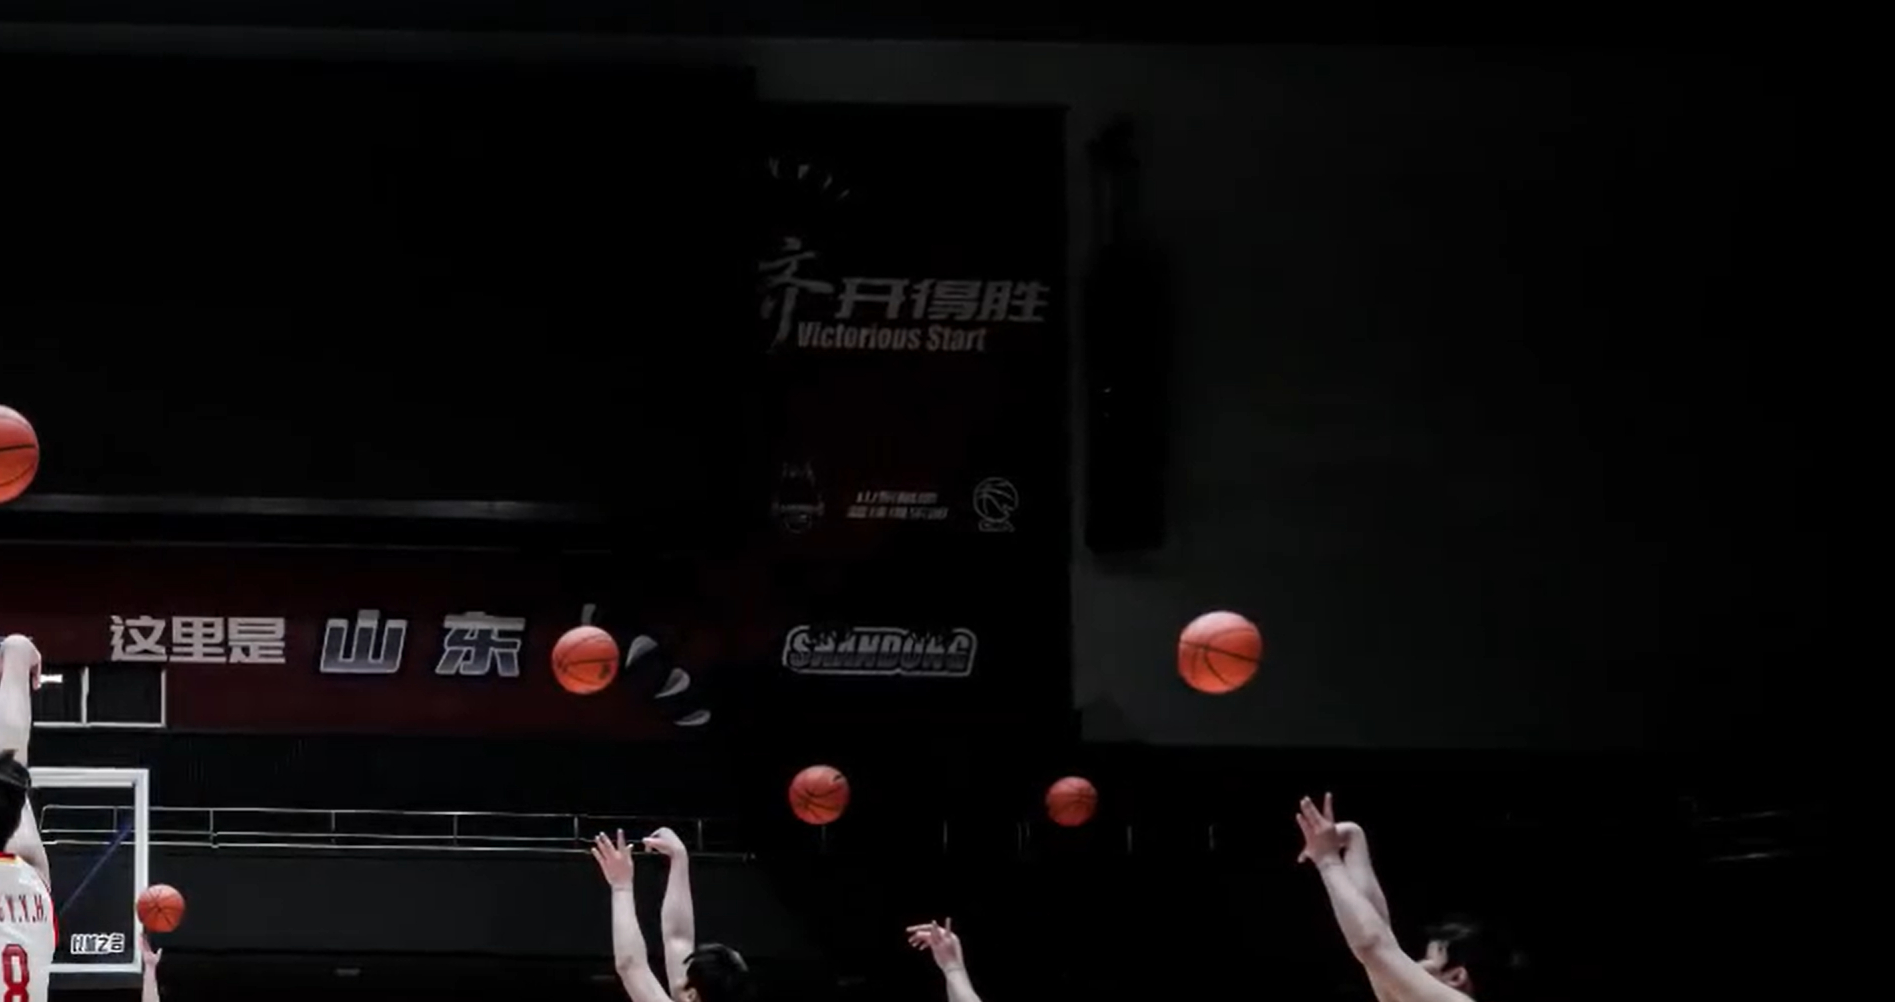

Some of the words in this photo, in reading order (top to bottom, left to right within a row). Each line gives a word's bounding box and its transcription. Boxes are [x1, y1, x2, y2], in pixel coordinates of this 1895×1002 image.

[797, 321, 922, 351] Victorious
[925, 322, 988, 352] Start
[110, 614, 287, 664] 这里是
